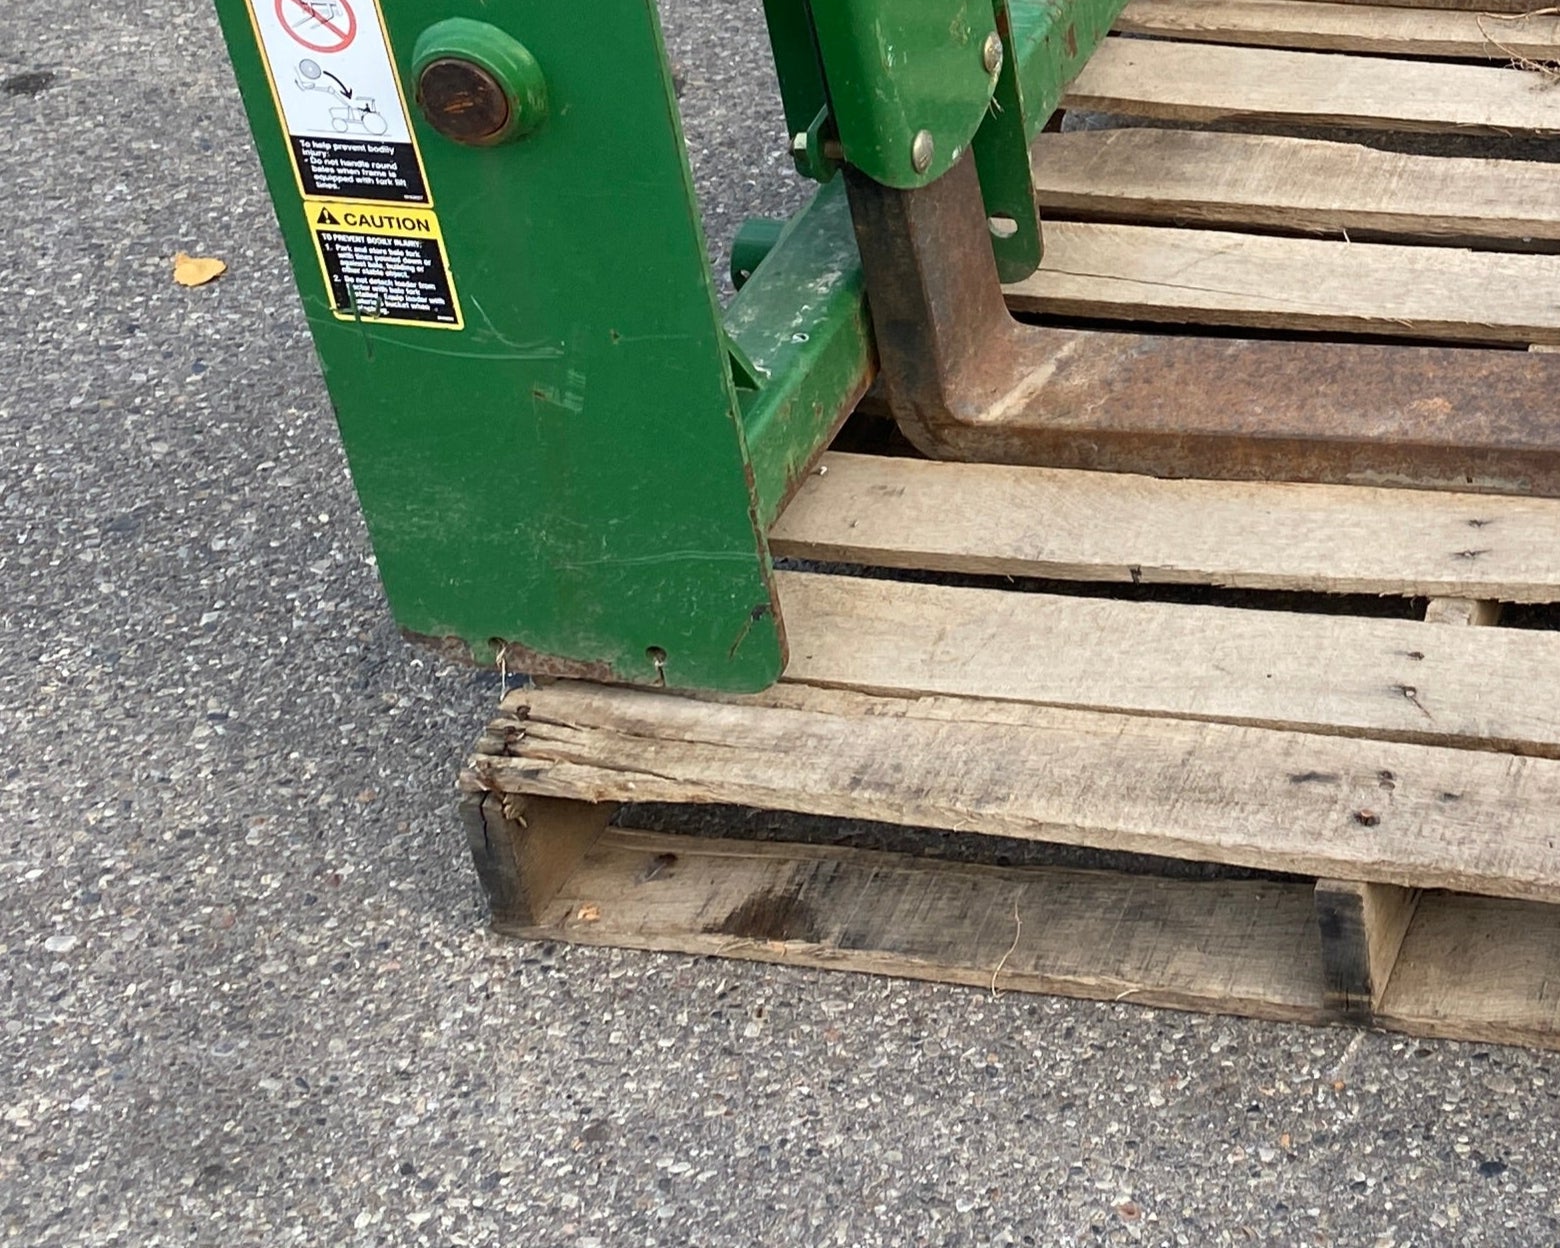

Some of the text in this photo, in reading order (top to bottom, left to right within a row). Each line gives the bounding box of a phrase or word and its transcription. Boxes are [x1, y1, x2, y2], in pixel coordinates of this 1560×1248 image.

[300, 140, 394, 156] To help prevent bodily
[310, 156, 398, 170] Do not handle round
[311, 165, 335, 173] bales
[336, 167, 360, 175] when
[362, 168, 387, 178] frame
[314, 174, 354, 184] equipped
[356, 176, 374, 185] with
[376, 178, 394, 186] fork
[344, 213, 430, 232] CAUTION
[333, 234, 365, 244] PREVENT
